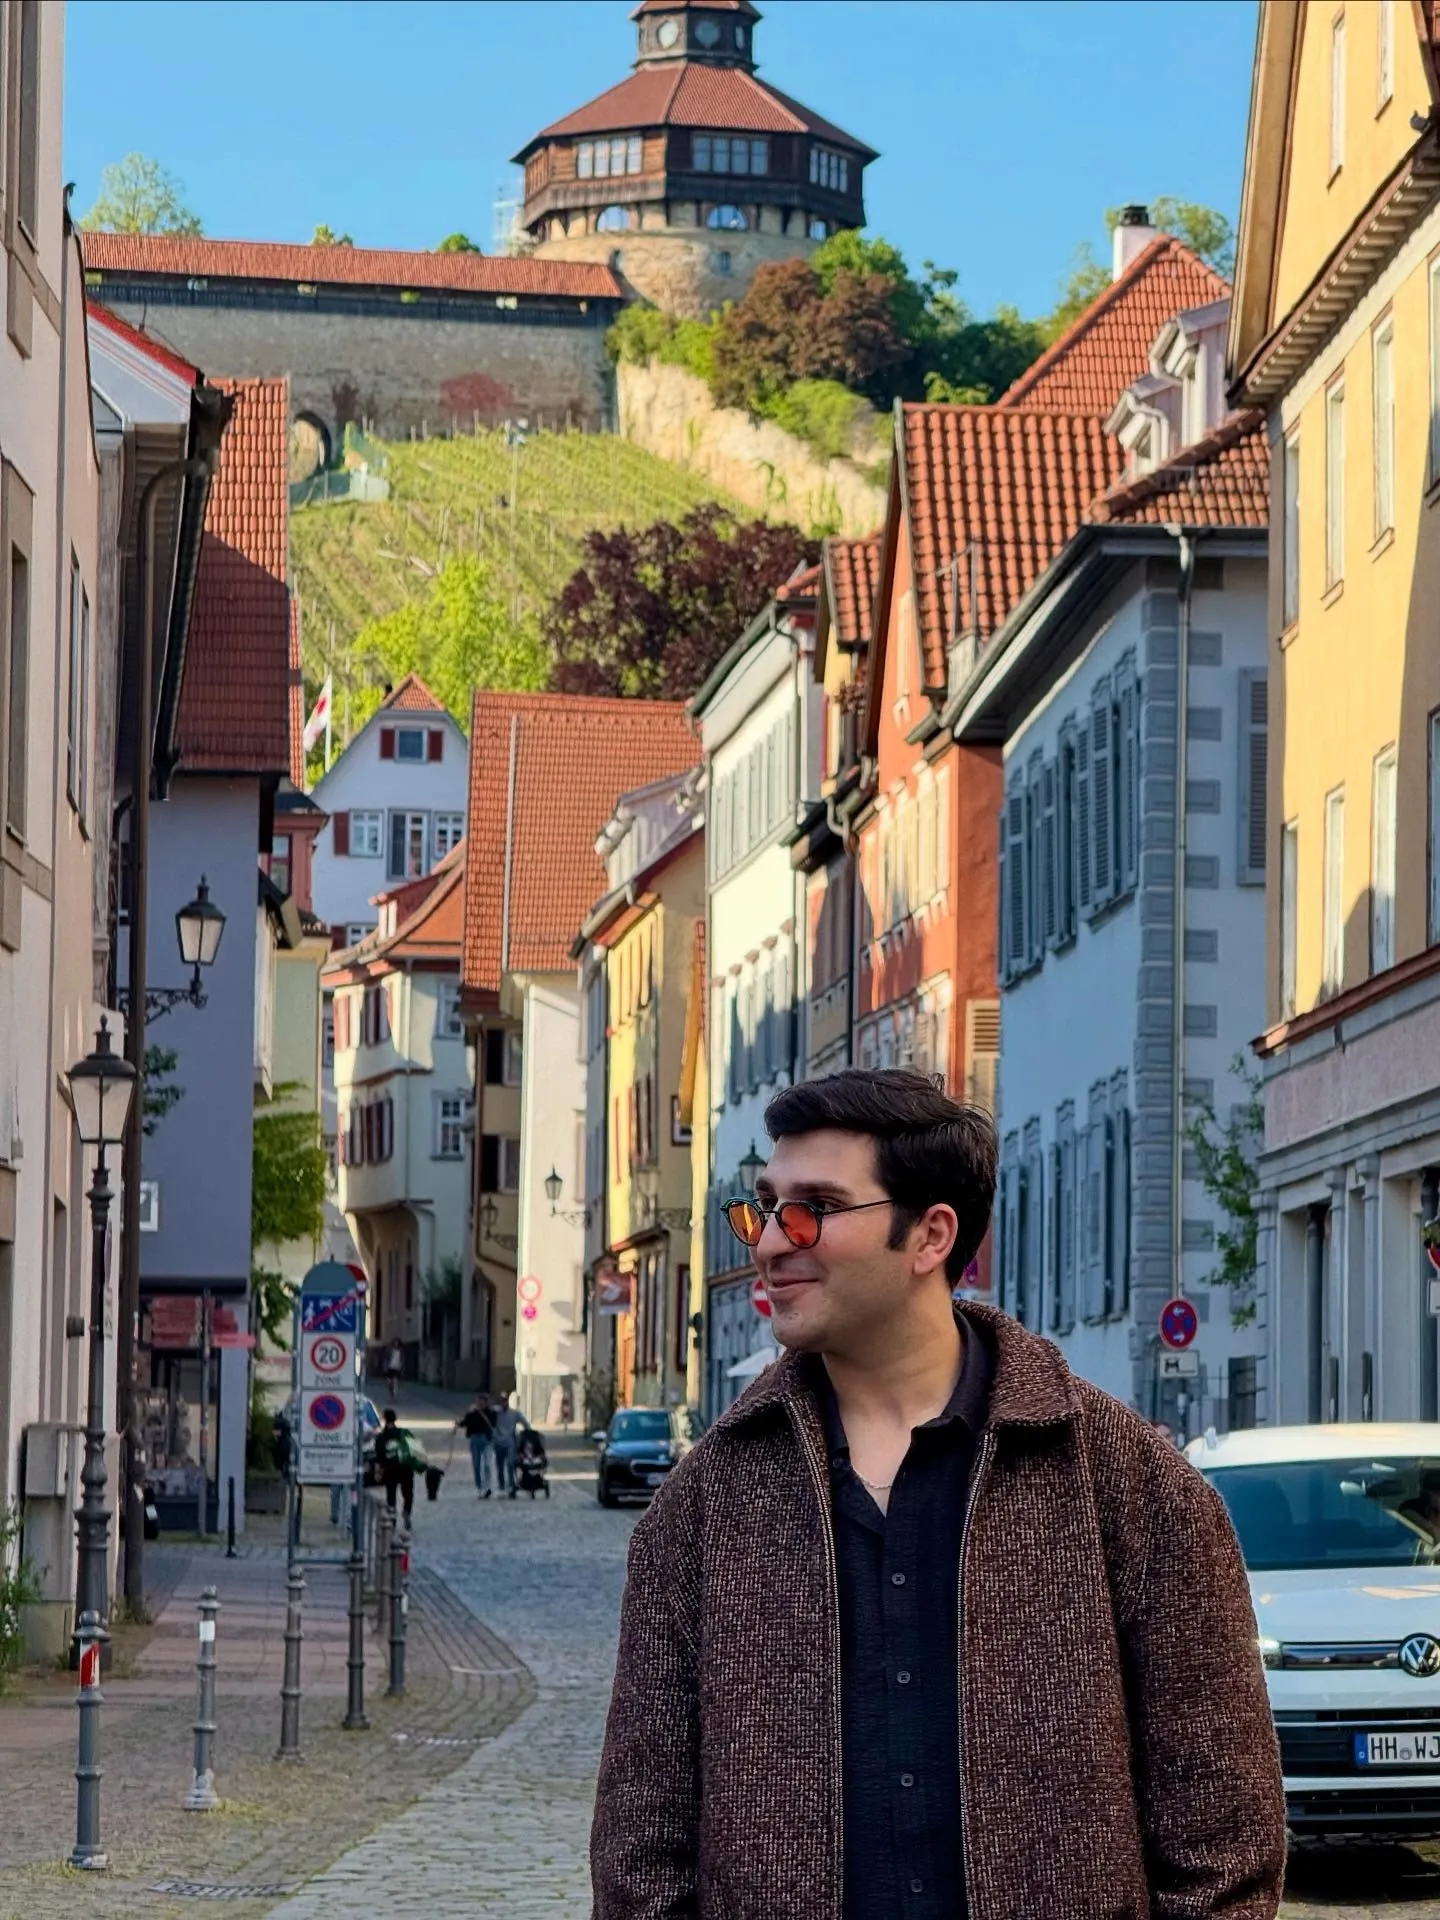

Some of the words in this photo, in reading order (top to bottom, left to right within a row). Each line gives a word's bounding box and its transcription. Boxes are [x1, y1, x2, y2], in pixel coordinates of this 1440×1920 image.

[319, 1345, 340, 1364] 20
[1370, 1736, 1398, 1760] HH
[1414, 1735, 1440, 1759] WJ
